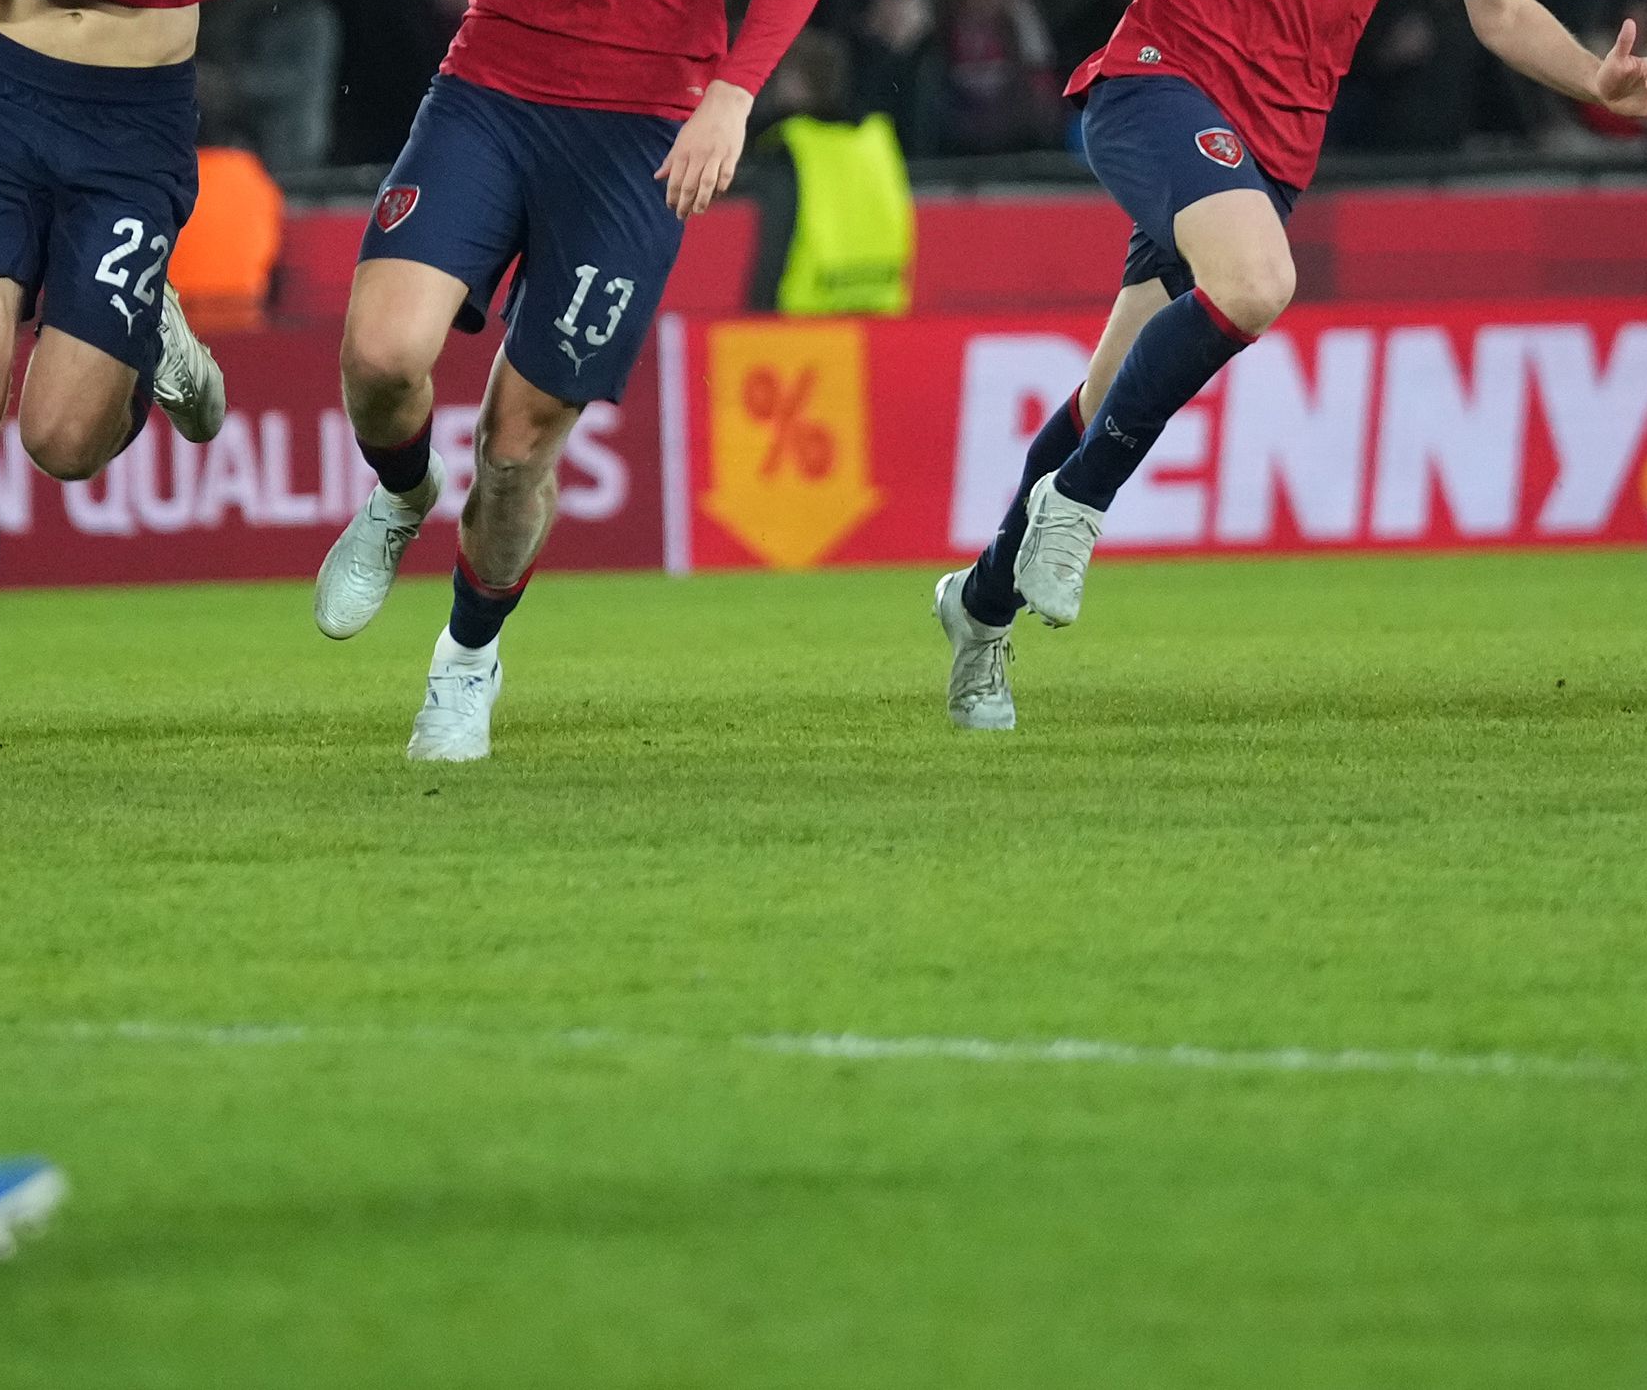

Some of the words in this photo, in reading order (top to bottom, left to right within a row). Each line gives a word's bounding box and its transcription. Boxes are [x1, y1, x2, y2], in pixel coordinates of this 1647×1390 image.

[95, 217, 170, 305] 22
[554, 264, 635, 348] 13
[1105, 414, 1138, 448] CZE
